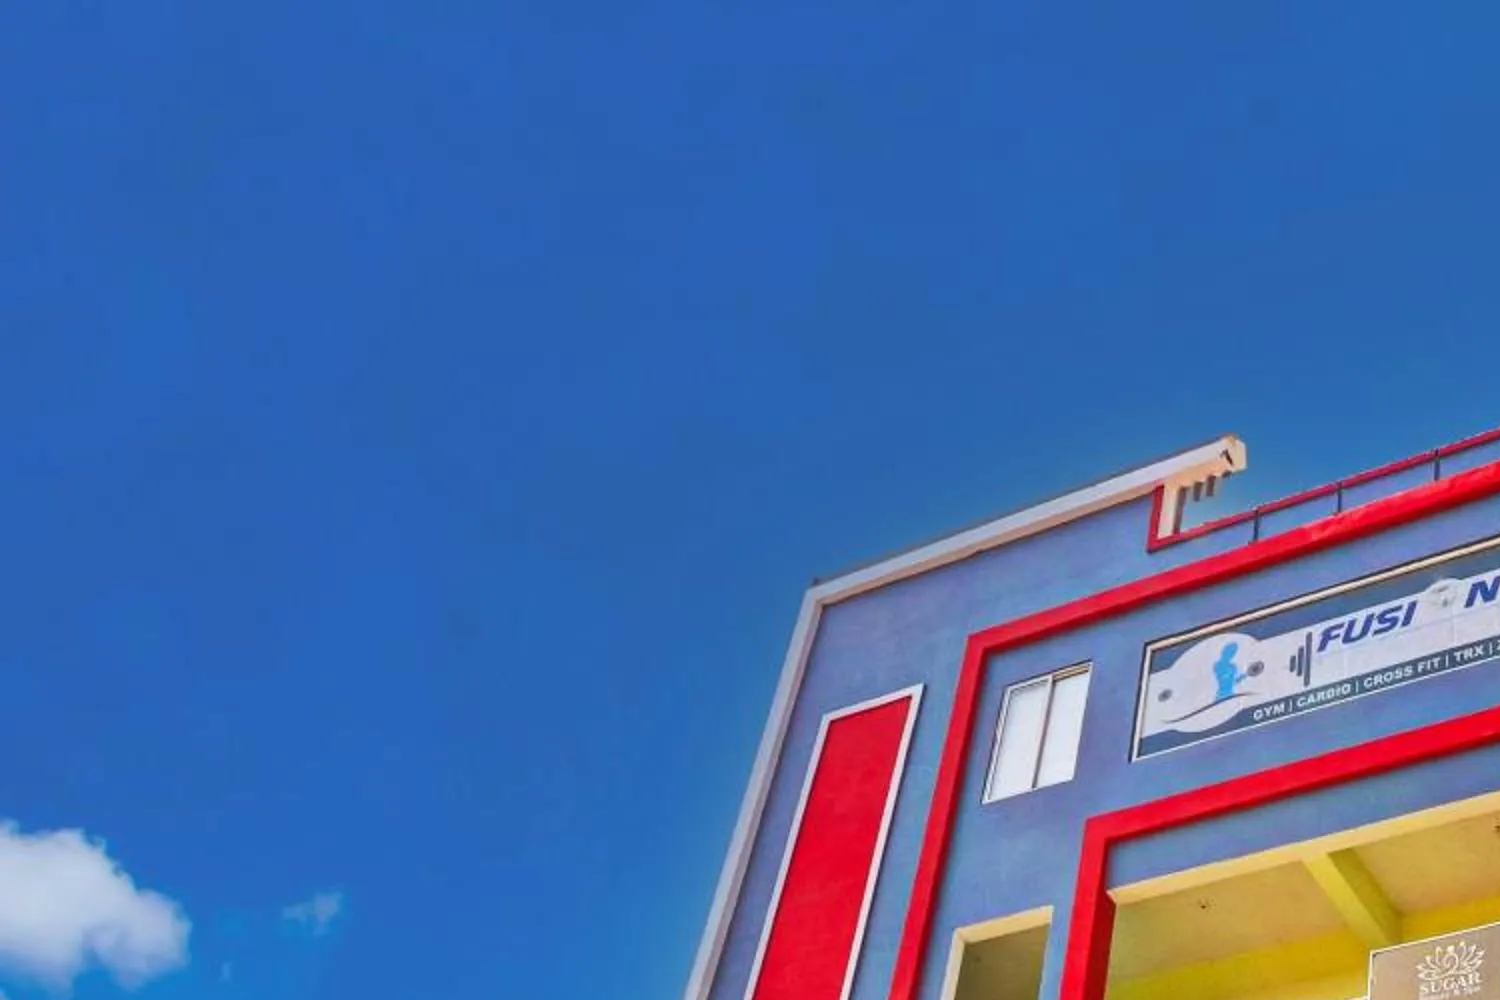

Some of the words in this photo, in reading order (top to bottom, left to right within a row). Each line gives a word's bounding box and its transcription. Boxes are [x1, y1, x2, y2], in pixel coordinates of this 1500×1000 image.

[1253, 701, 1286, 721] GYM
[1297, 683, 1351, 708] CARDIO
[1363, 665, 1413, 689] CROSS
[1418, 657, 1442, 674] FIT
[1454, 645, 1485, 663] TRX
[1419, 972, 1483, 993] SUGAR
